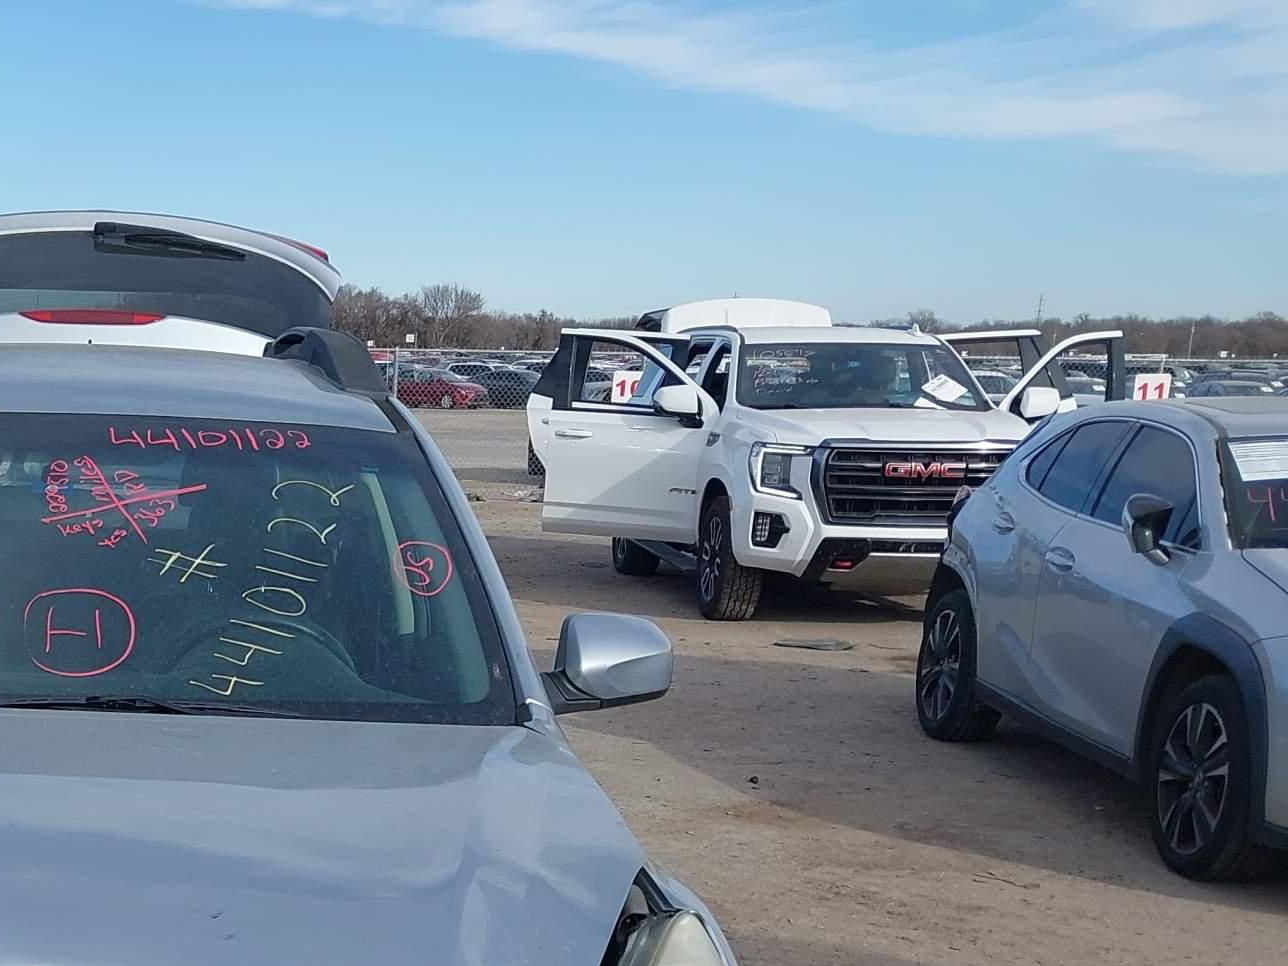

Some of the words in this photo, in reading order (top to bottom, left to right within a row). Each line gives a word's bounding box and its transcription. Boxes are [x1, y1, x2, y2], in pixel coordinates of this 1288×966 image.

[1137, 382, 1166, 400] 11
[110, 427, 312, 451] 44101122
[885, 462, 967, 478] GMC
[189, 480, 355, 695] 44101122
